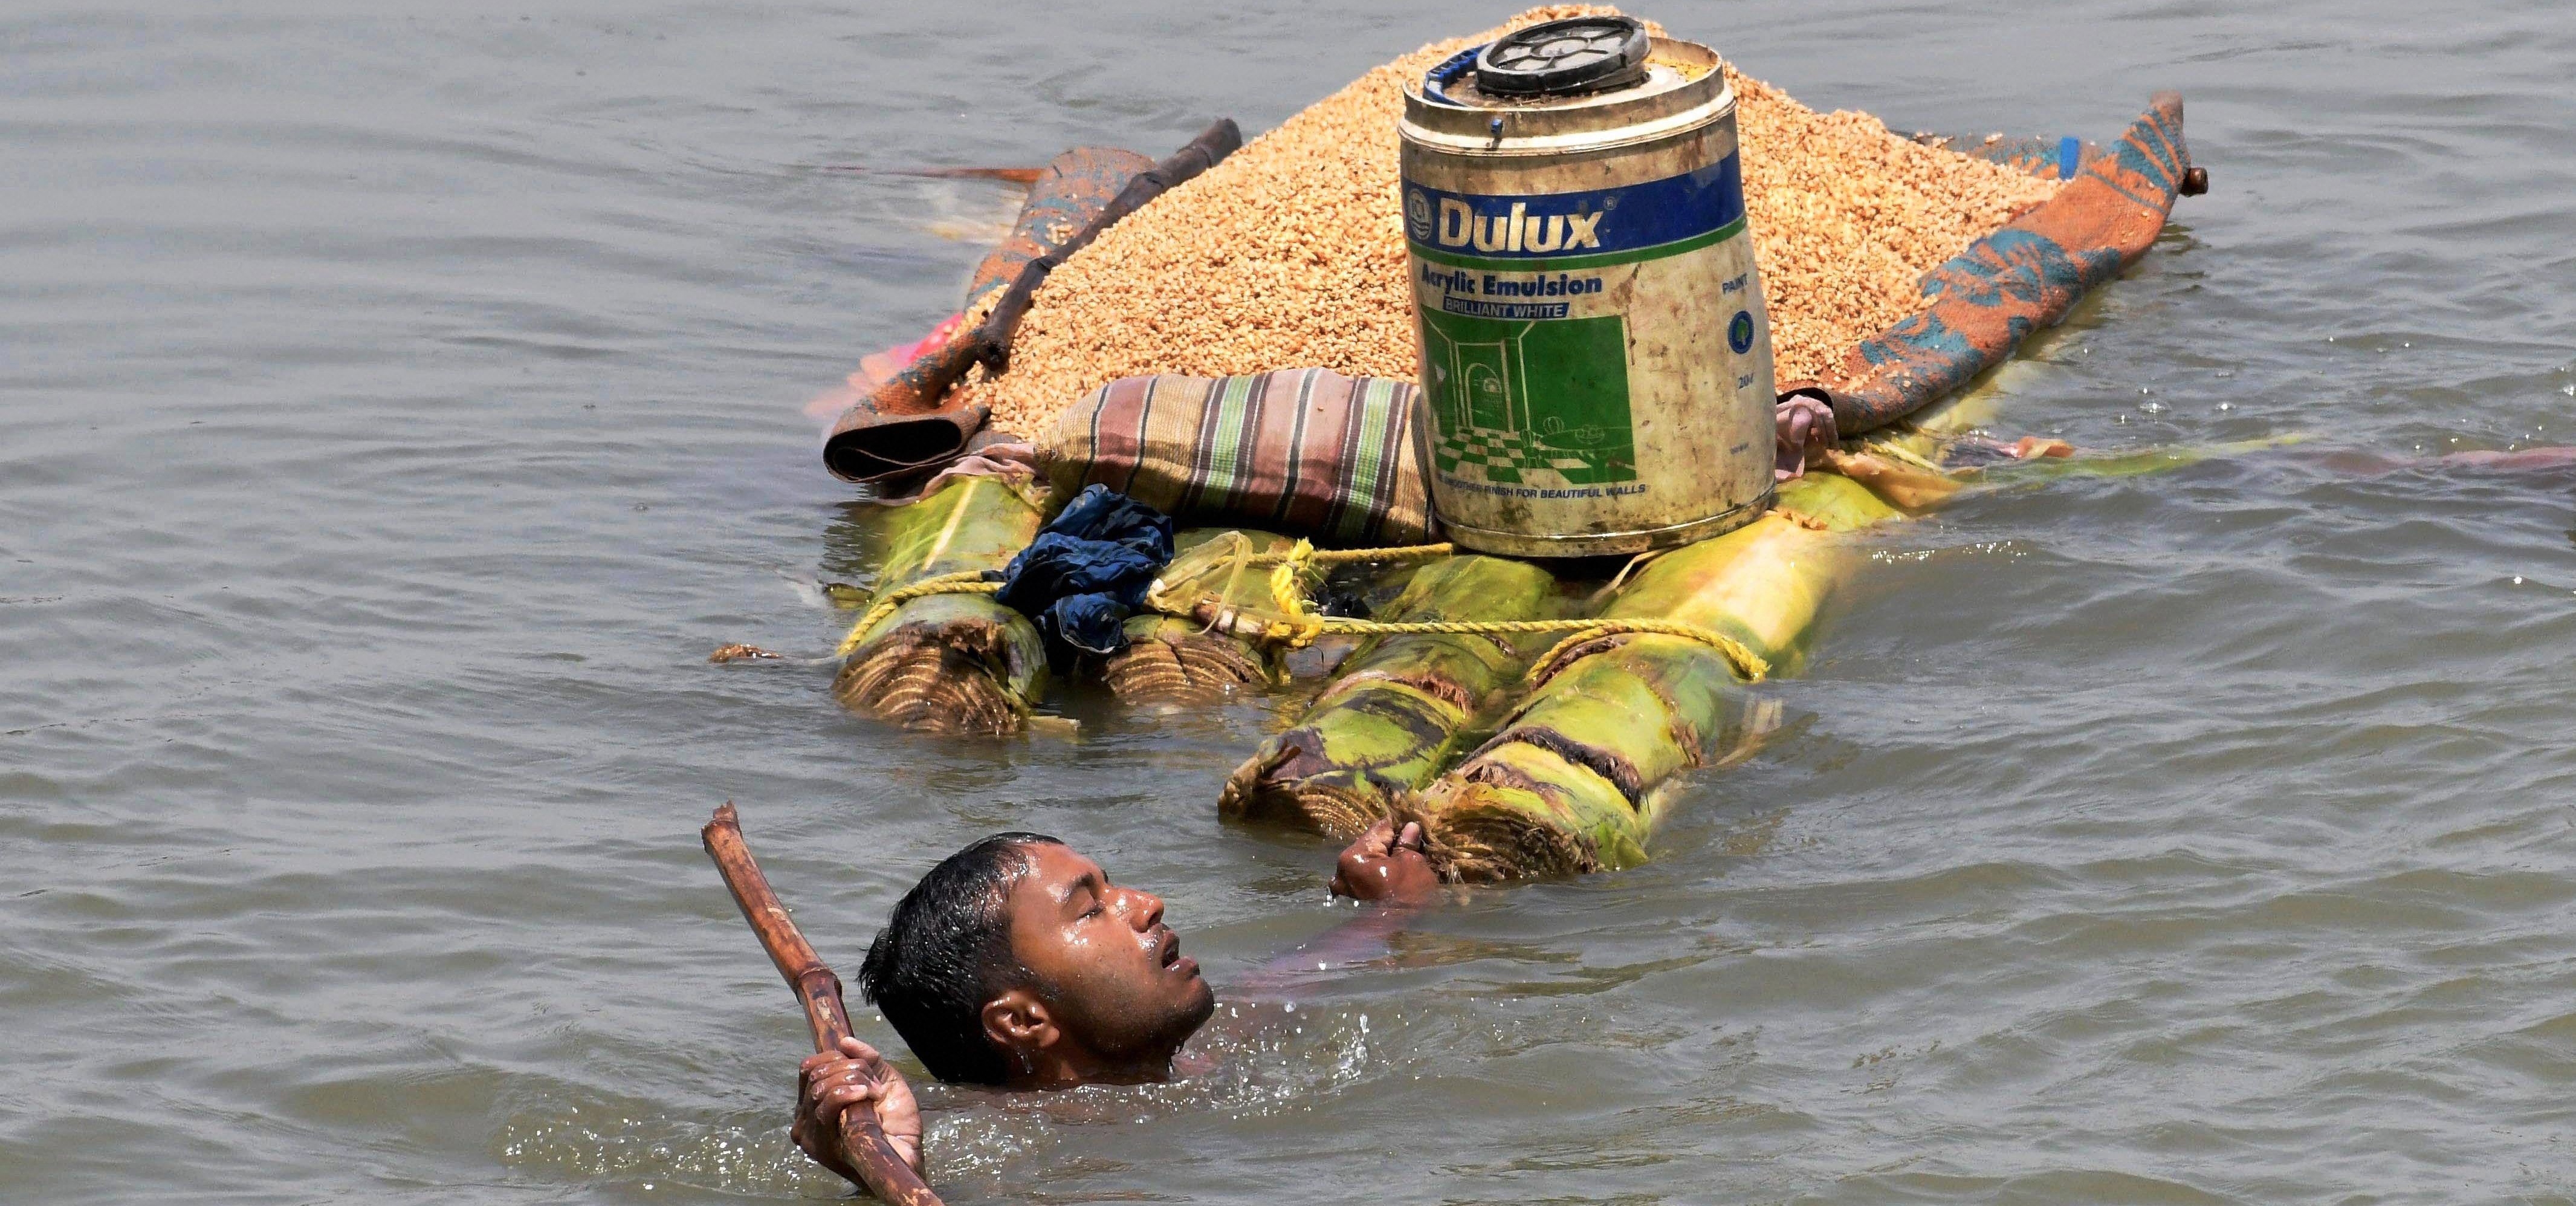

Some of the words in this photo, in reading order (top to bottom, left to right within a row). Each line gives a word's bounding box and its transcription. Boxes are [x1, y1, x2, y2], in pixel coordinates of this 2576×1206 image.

[1439, 198, 1604, 253] Dulux
[1422, 262, 1475, 294] Acrylic
[1483, 273, 1602, 296] Emulsion
[1445, 297, 1510, 317] BRILLIANT
[1513, 304, 1564, 317] WHITE
[1484, 485, 1513, 496] FINISH
[1516, 488, 1538, 499] FOR
[1540, 487, 1603, 499] BEAUTIFUL
[1605, 484, 1646, 497] WALLS
